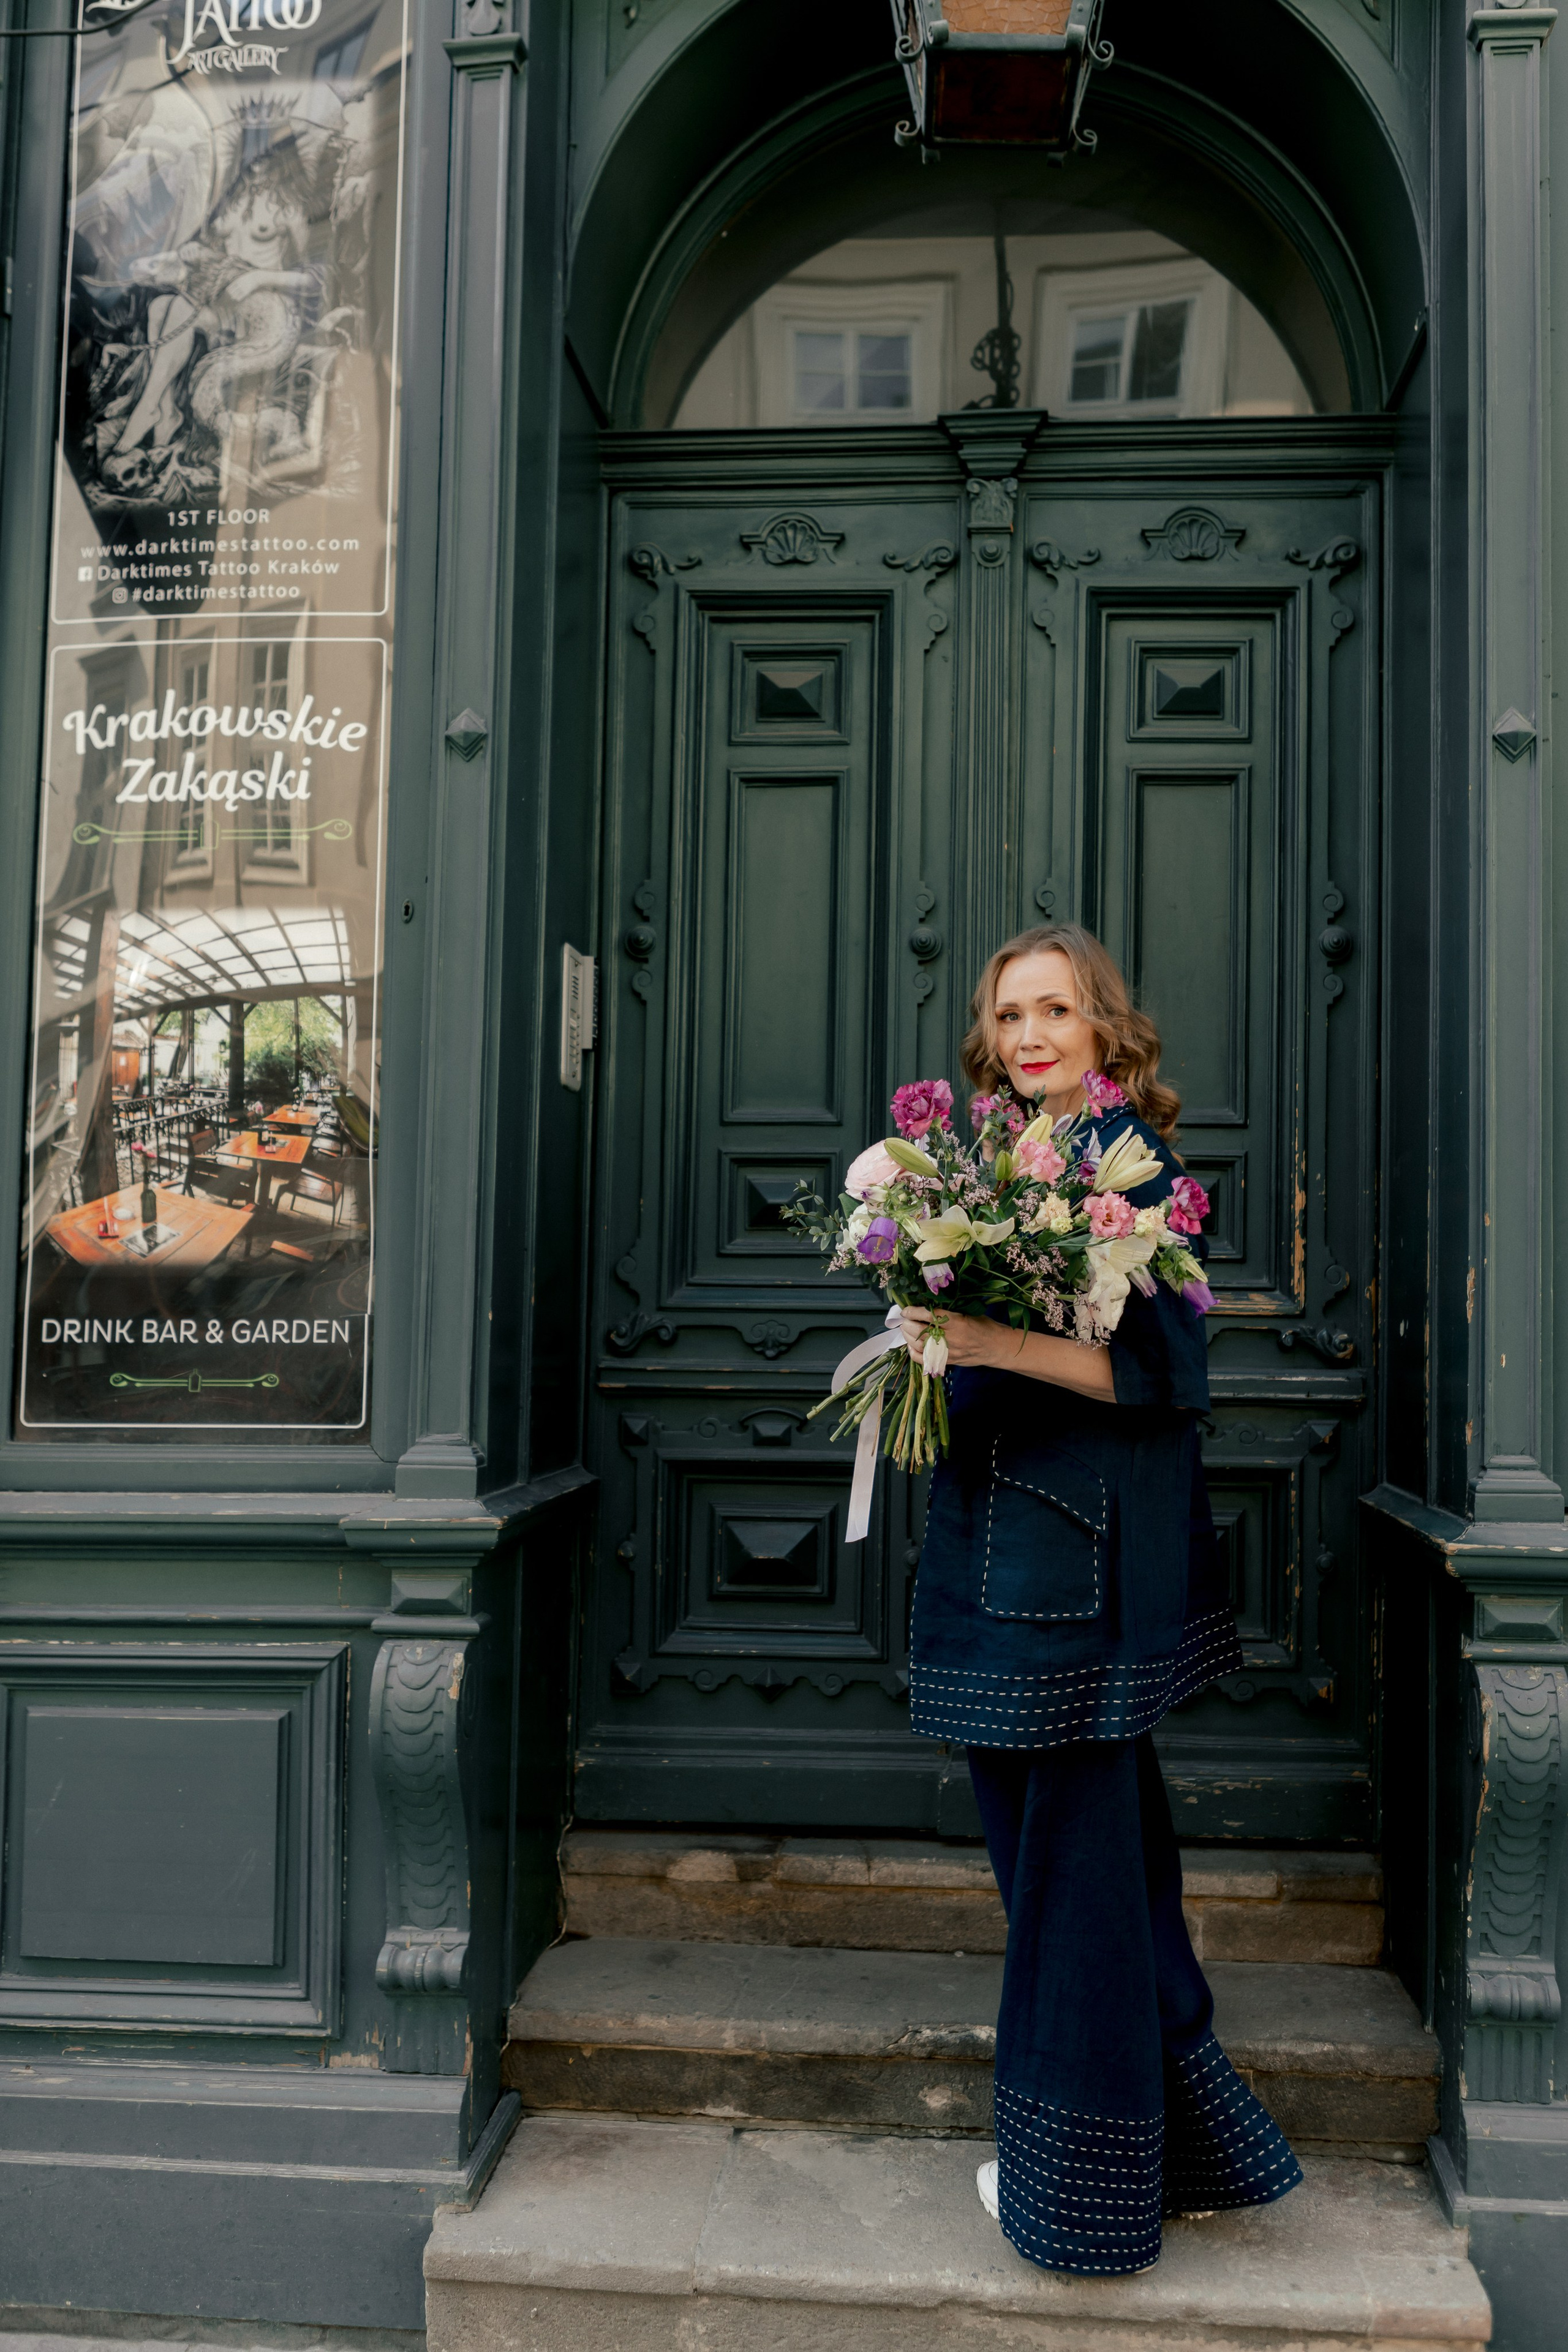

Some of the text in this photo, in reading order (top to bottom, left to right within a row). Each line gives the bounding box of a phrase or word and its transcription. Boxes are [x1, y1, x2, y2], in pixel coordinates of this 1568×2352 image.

[167, 508, 270, 526] 1ST FLOOR
[80, 538, 360, 558] www.darktimestattoo.com
[97, 559, 339, 581] Darktimes Tattoo Kraków
[132, 585, 300, 602] #darktimestattoo
[62, 688, 367, 755] Krakowskie
[115, 751, 312, 812] Zakąski
[41, 1319, 350, 1344] DRINK BAR & GARDEN
